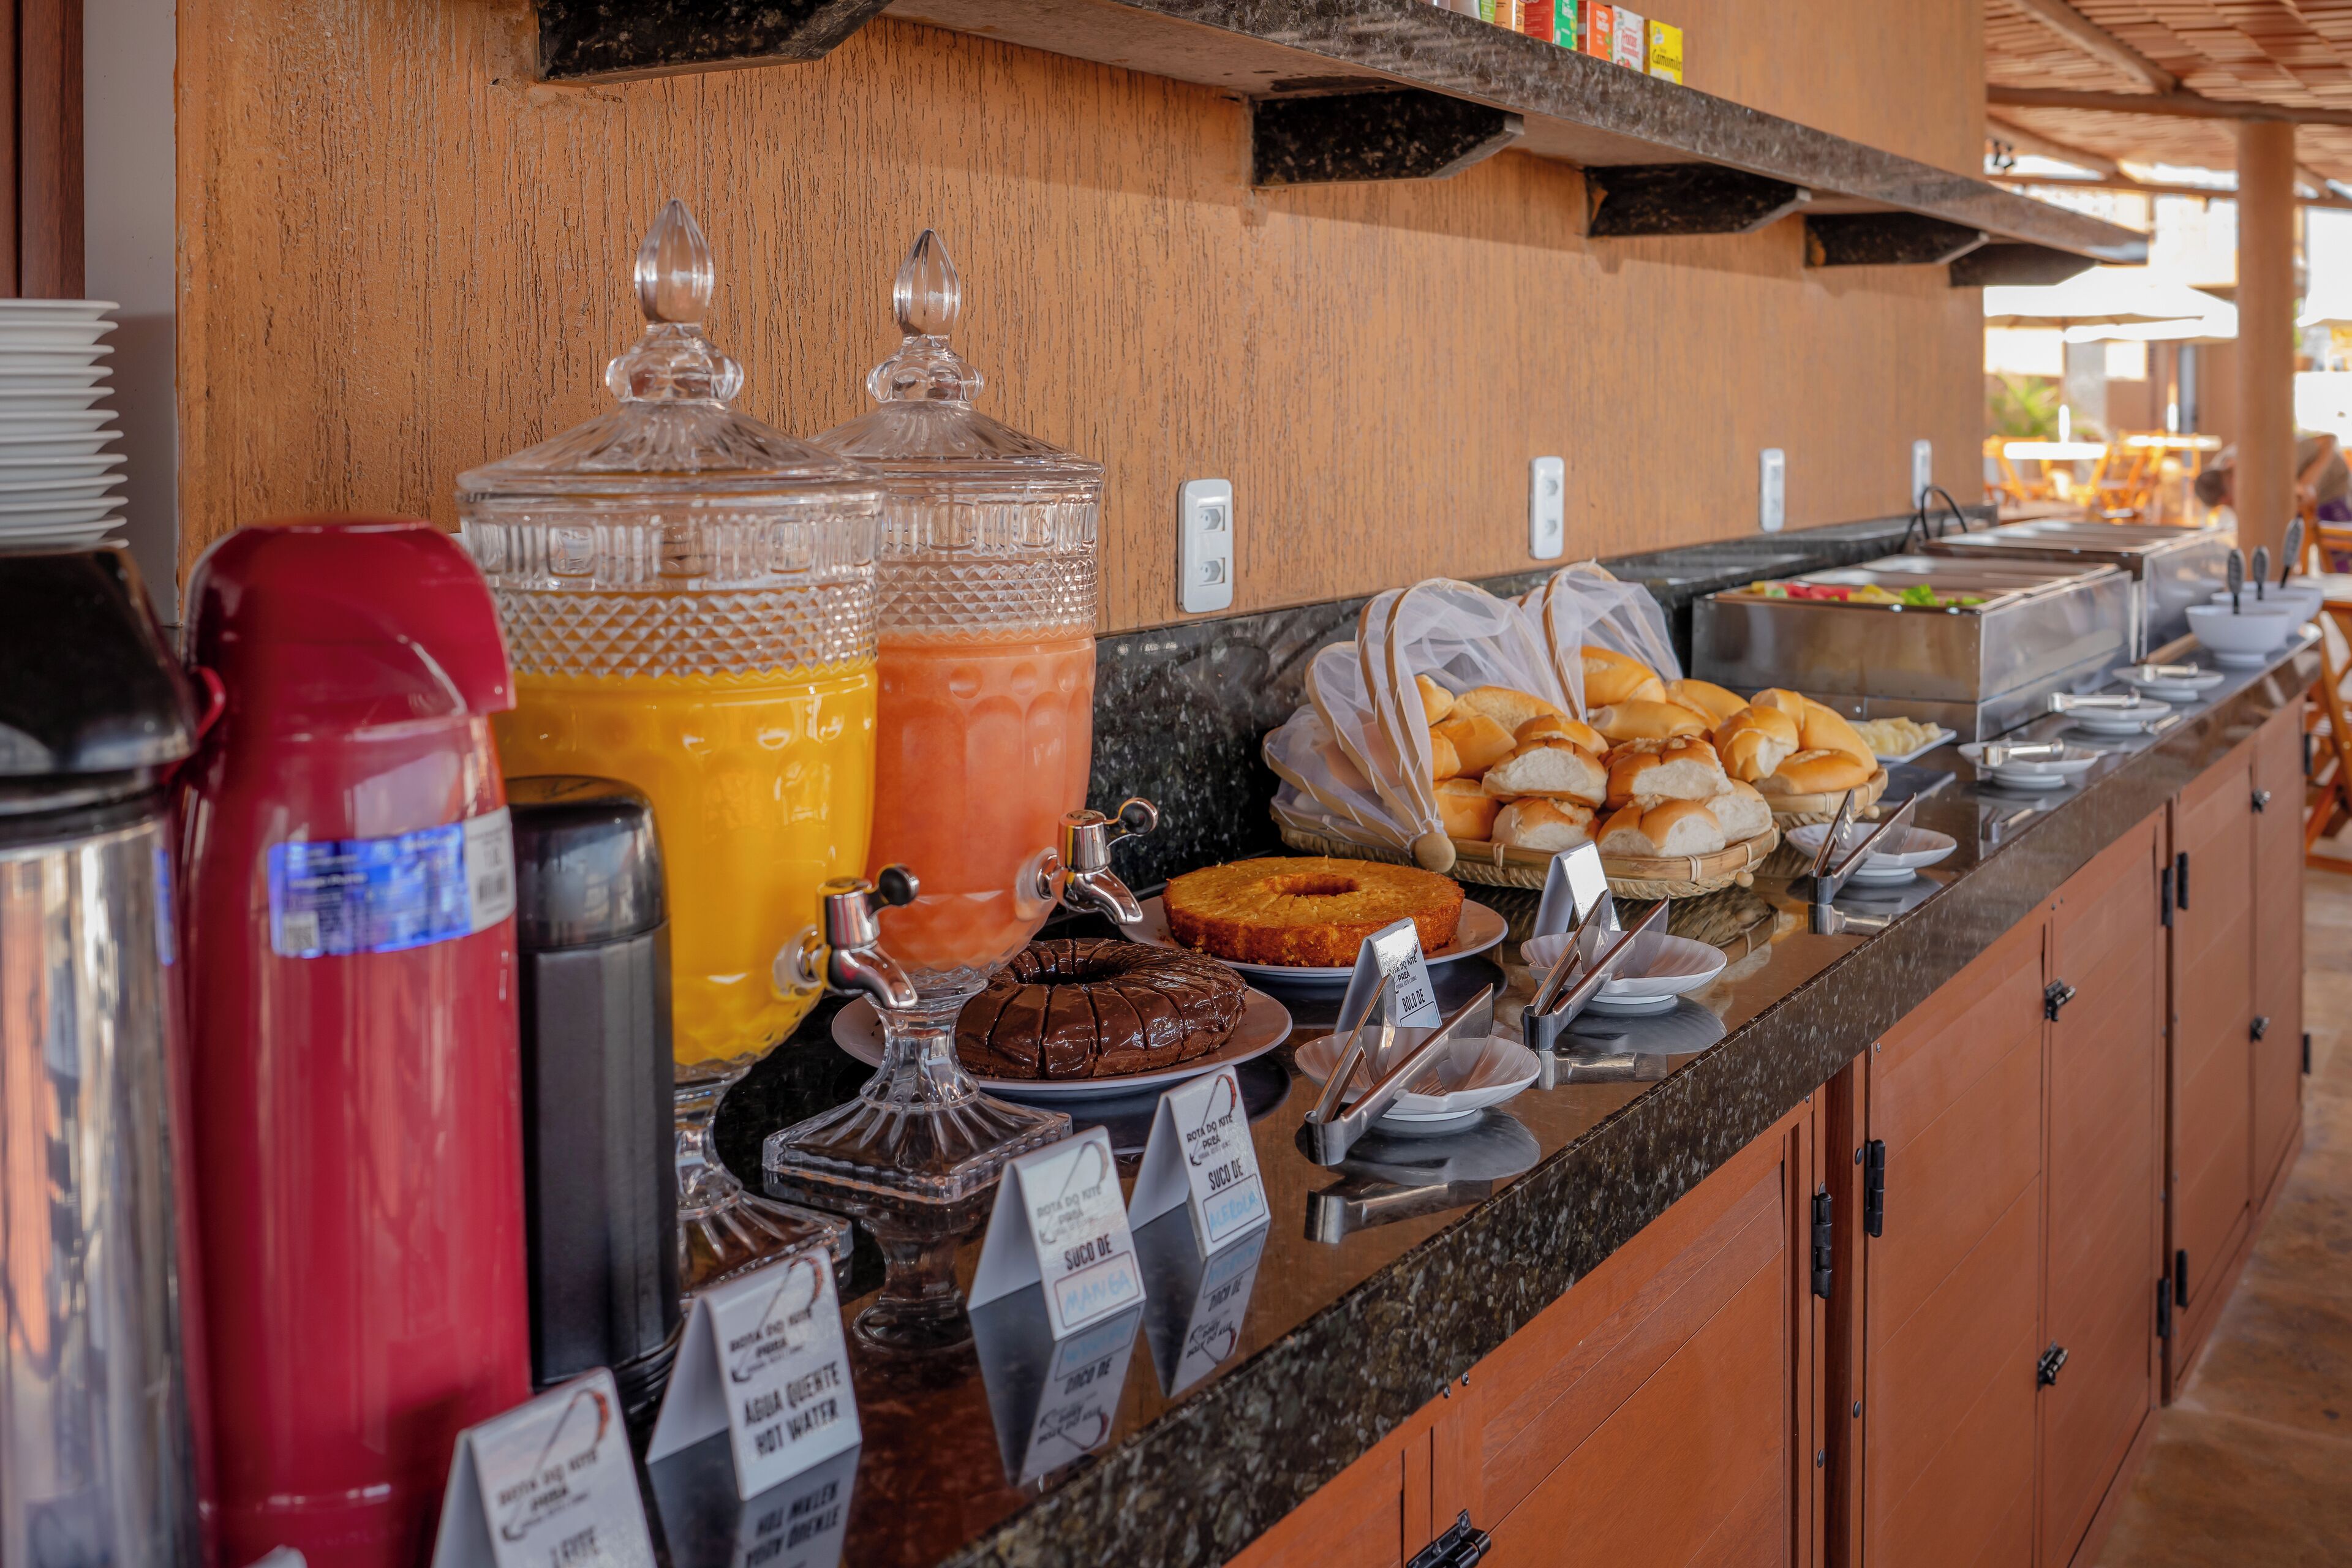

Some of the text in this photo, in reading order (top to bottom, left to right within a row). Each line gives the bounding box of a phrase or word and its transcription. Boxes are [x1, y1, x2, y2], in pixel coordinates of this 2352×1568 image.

[1397, 968, 1411, 982] PREÁ
[1408, 956, 1417, 967] KITE
[1402, 989, 1426, 1012] BOLO DE
[1187, 1115, 1233, 1142] ROTA DO KITE
[1208, 1158, 1243, 1190] SUCO DE
[1036, 1185, 1102, 1218] ROTA DO KITE
[1065, 1233, 1112, 1271] SUCO DE
[1065, 1268, 1133, 1318] MANGA
[786, 1360, 840, 1408] QUENTE
[755, 1397, 839, 1457] HOT WATER
